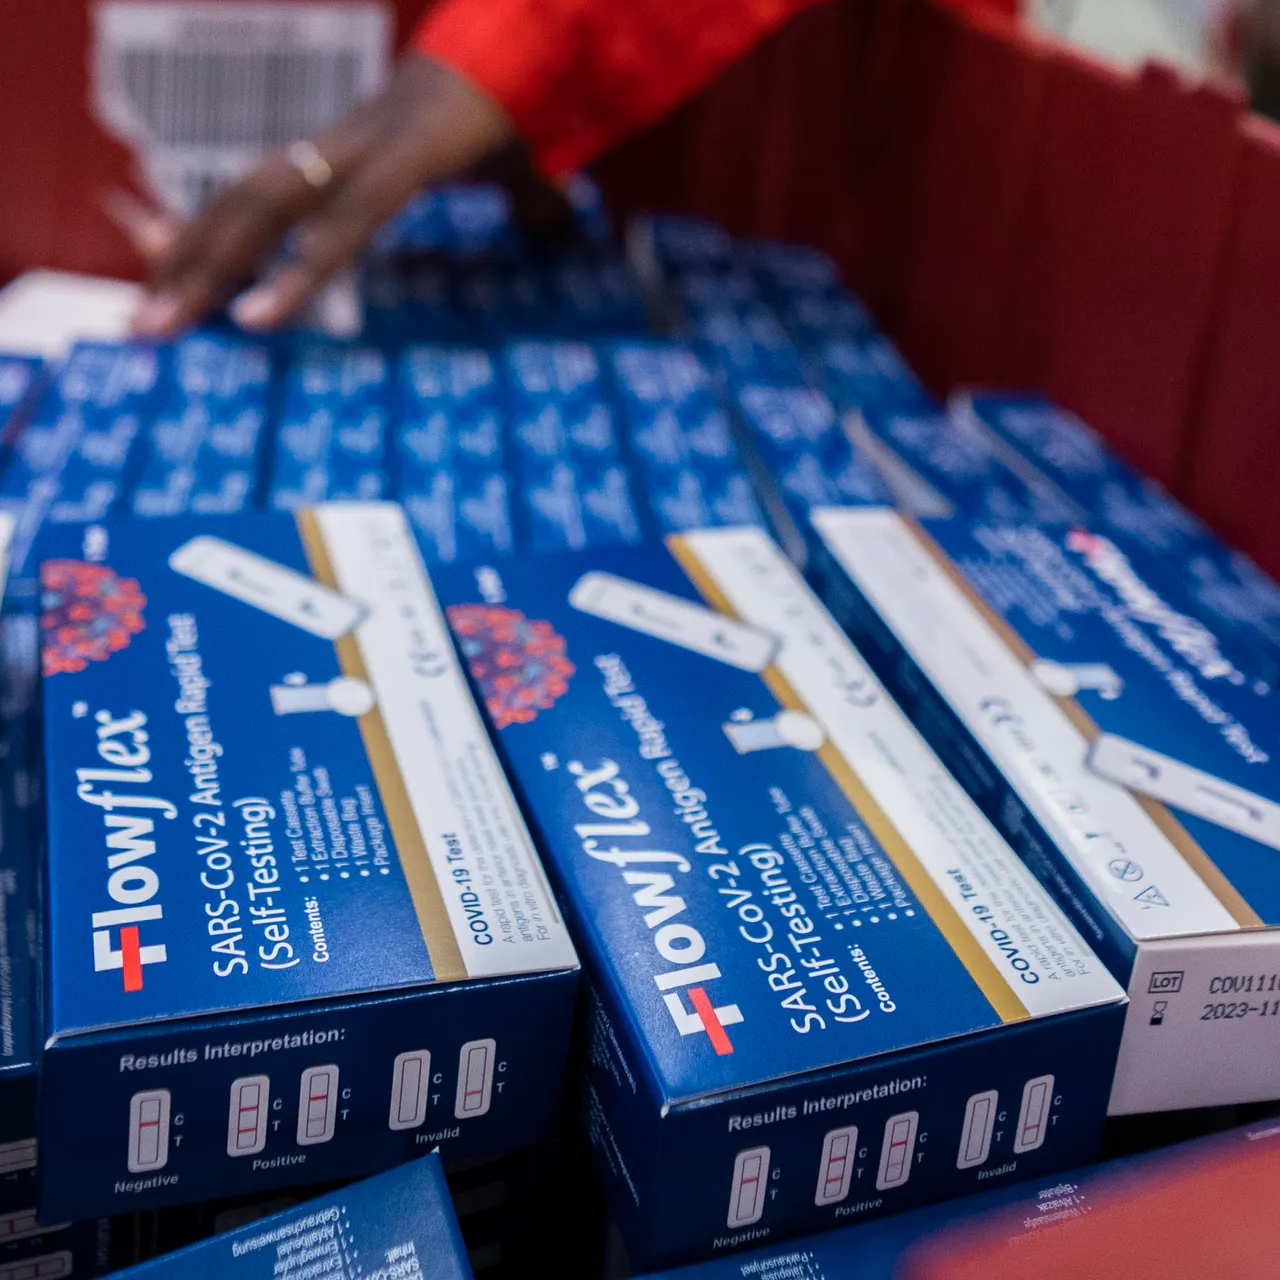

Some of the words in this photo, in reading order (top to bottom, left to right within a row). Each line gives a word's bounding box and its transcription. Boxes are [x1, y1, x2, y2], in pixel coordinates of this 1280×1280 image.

[168, 651, 210, 713] Rapid
[184, 715, 223, 805] Antigen
[657, 760, 728, 854] Antigen
[304, 807, 328, 861] Extraction
[366, 817, 390, 865] Package
[75, 710, 178, 992] Flowflex
[290, 840, 307, 863] Test
[442, 834, 464, 864] Test
[193, 812, 248, 976] SARS-CoV-2
[233, 798, 300, 969] (Self-Testing)
[947, 869, 977, 901] Test
[452, 869, 493, 945] COVID-19
[486, 889, 502, 906] test
[567, 760, 746, 1056] Flowflex
[810, 885, 832, 910] Test
[304, 897, 330, 963] Contents:
[492, 909, 512, 933] rapid
[536, 925, 551, 940] For
[739, 844, 870, 1022] (Self-Testing)
[708, 861, 825, 1033] SARS-CoV-2
[973, 906, 1039, 984] COVID-19
[848, 944, 896, 1012] Contents:
[120, 1048, 197, 1072] Results
[205, 1029, 345, 1060] Interpretation:
[497, 1060, 507, 1072] C
[433, 1072, 442, 1084] C
[495, 1081, 504, 1093] T
[272, 1098, 282, 1111] C
[342, 1087, 351, 1099] C
[431, 1093, 440, 1105] T
[729, 1106, 797, 1132] Results
[804, 1076, 926, 1115] Interpretation:
[174, 1112, 184, 1126] C
[272, 1120, 280, 1132] T
[340, 1109, 349, 1121] T
[1050, 1114, 1059, 1126] T
[173, 1134, 183, 1147] T
[416, 1127, 459, 1143] Invalid
[994, 1130, 1003, 1142] T
[253, 1155, 306, 1170] Positive
[916, 1152, 924, 1163] T
[855, 1167, 864, 1179] T
[978, 1161, 1016, 1179] Invalid
[115, 1176, 178, 1193] Negative
[769, 1188, 778, 1200] T
[835, 1199, 882, 1217] Positive
[232, 1206, 339, 1257] Gebrauchsanweisung
[277, 1224, 337, 1261] Abfallbeutel
[713, 1228, 770, 1248] Negative
[274, 1238, 339, 1275] Einwegtupfer
[385, 1241, 415, 1264] Inhalt:
